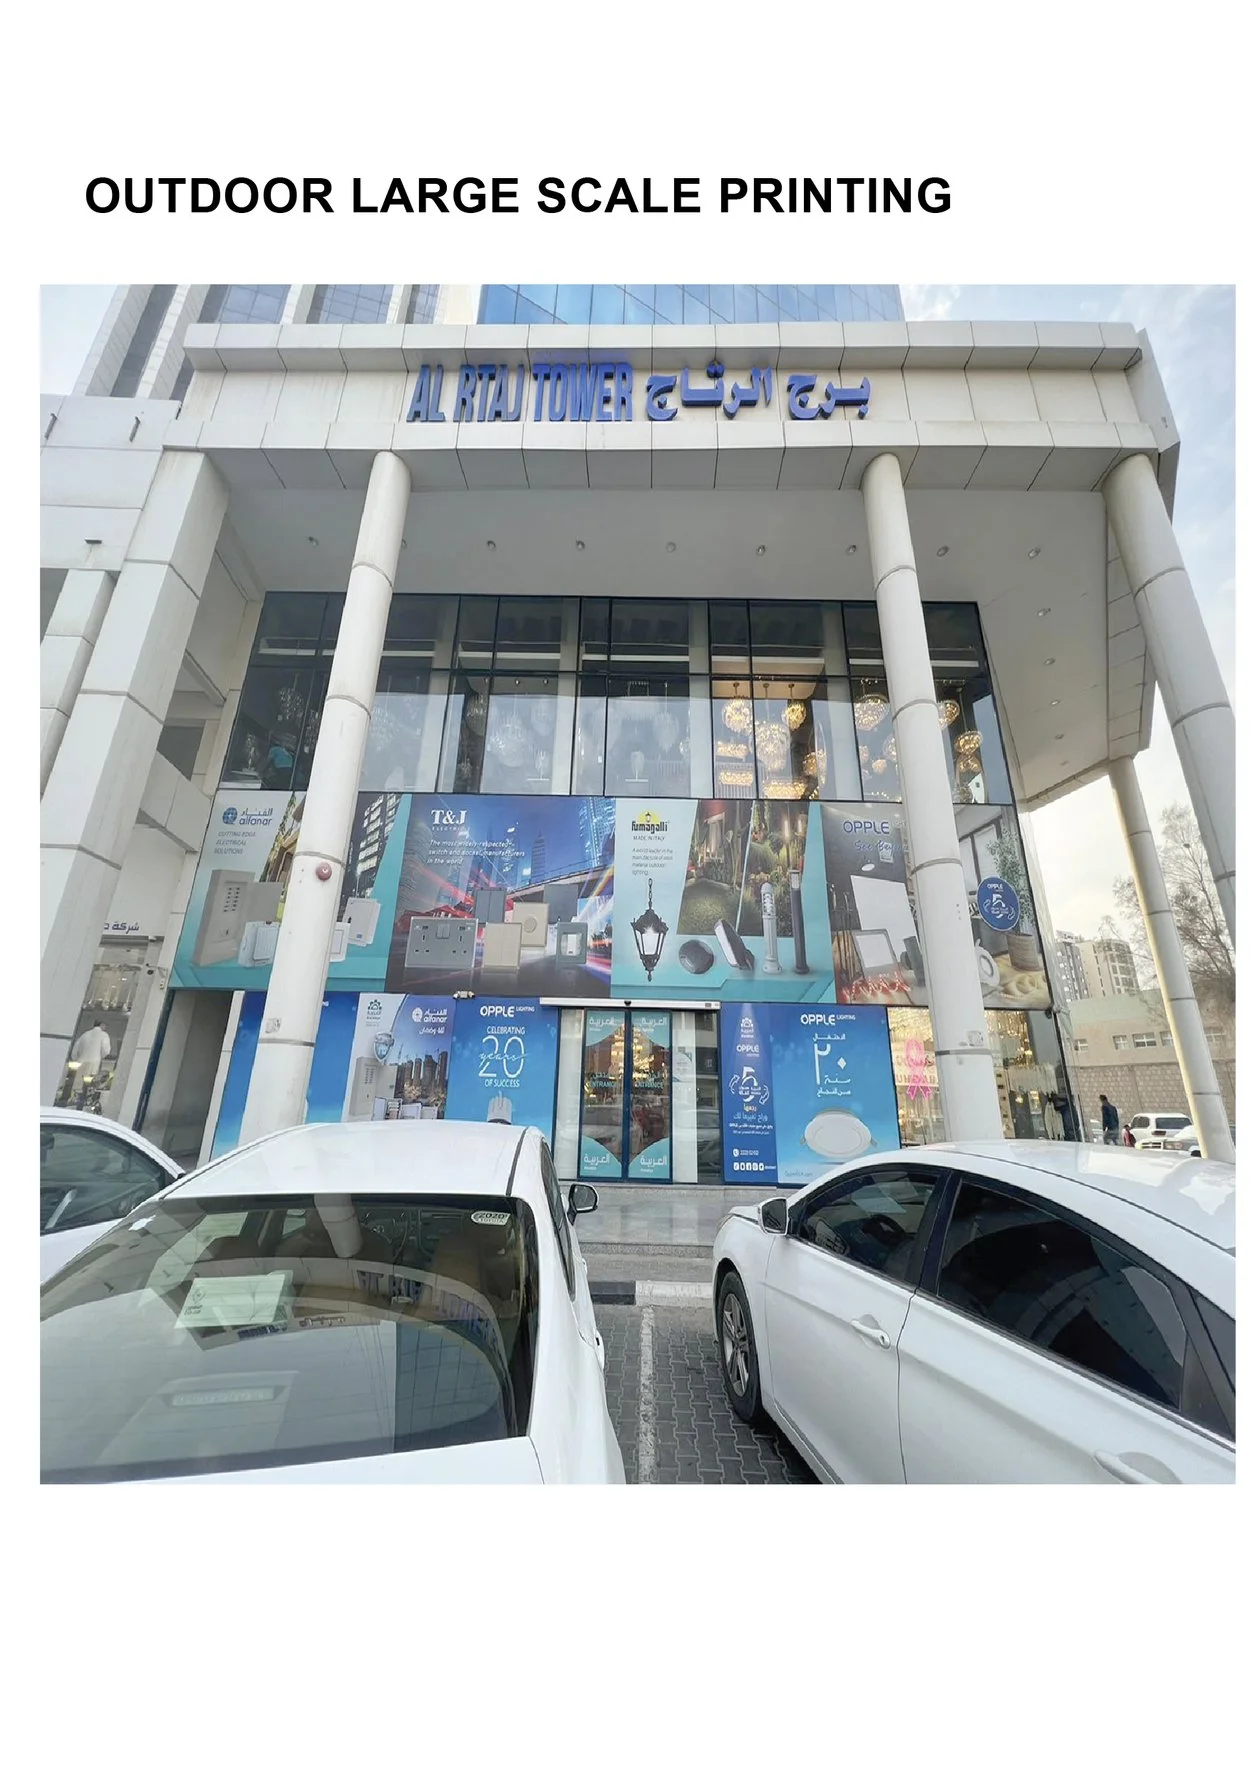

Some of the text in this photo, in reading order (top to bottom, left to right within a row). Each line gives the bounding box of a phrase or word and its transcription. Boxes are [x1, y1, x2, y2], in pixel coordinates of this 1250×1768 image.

[406, 362, 634, 423] AL RTAJ TOWER
[646, 359, 872, 421] برج الرتاج
[239, 816, 273, 826] alfanar
[431, 809, 467, 825] T&J
[631, 820, 668, 834] fumagalli
[843, 820, 890, 835] OPPLE
[480, 1005, 515, 1017] OPPLE
[801, 1014, 836, 1026] OPPLE
[486, 1026, 526, 1035] CELEBRATING
[736, 1044, 760, 1053] OPPLE
[478, 1035, 525, 1078] 20
[484, 1079, 520, 1088] OF SUCCESS
[639, 1155, 667, 1168] العربية
